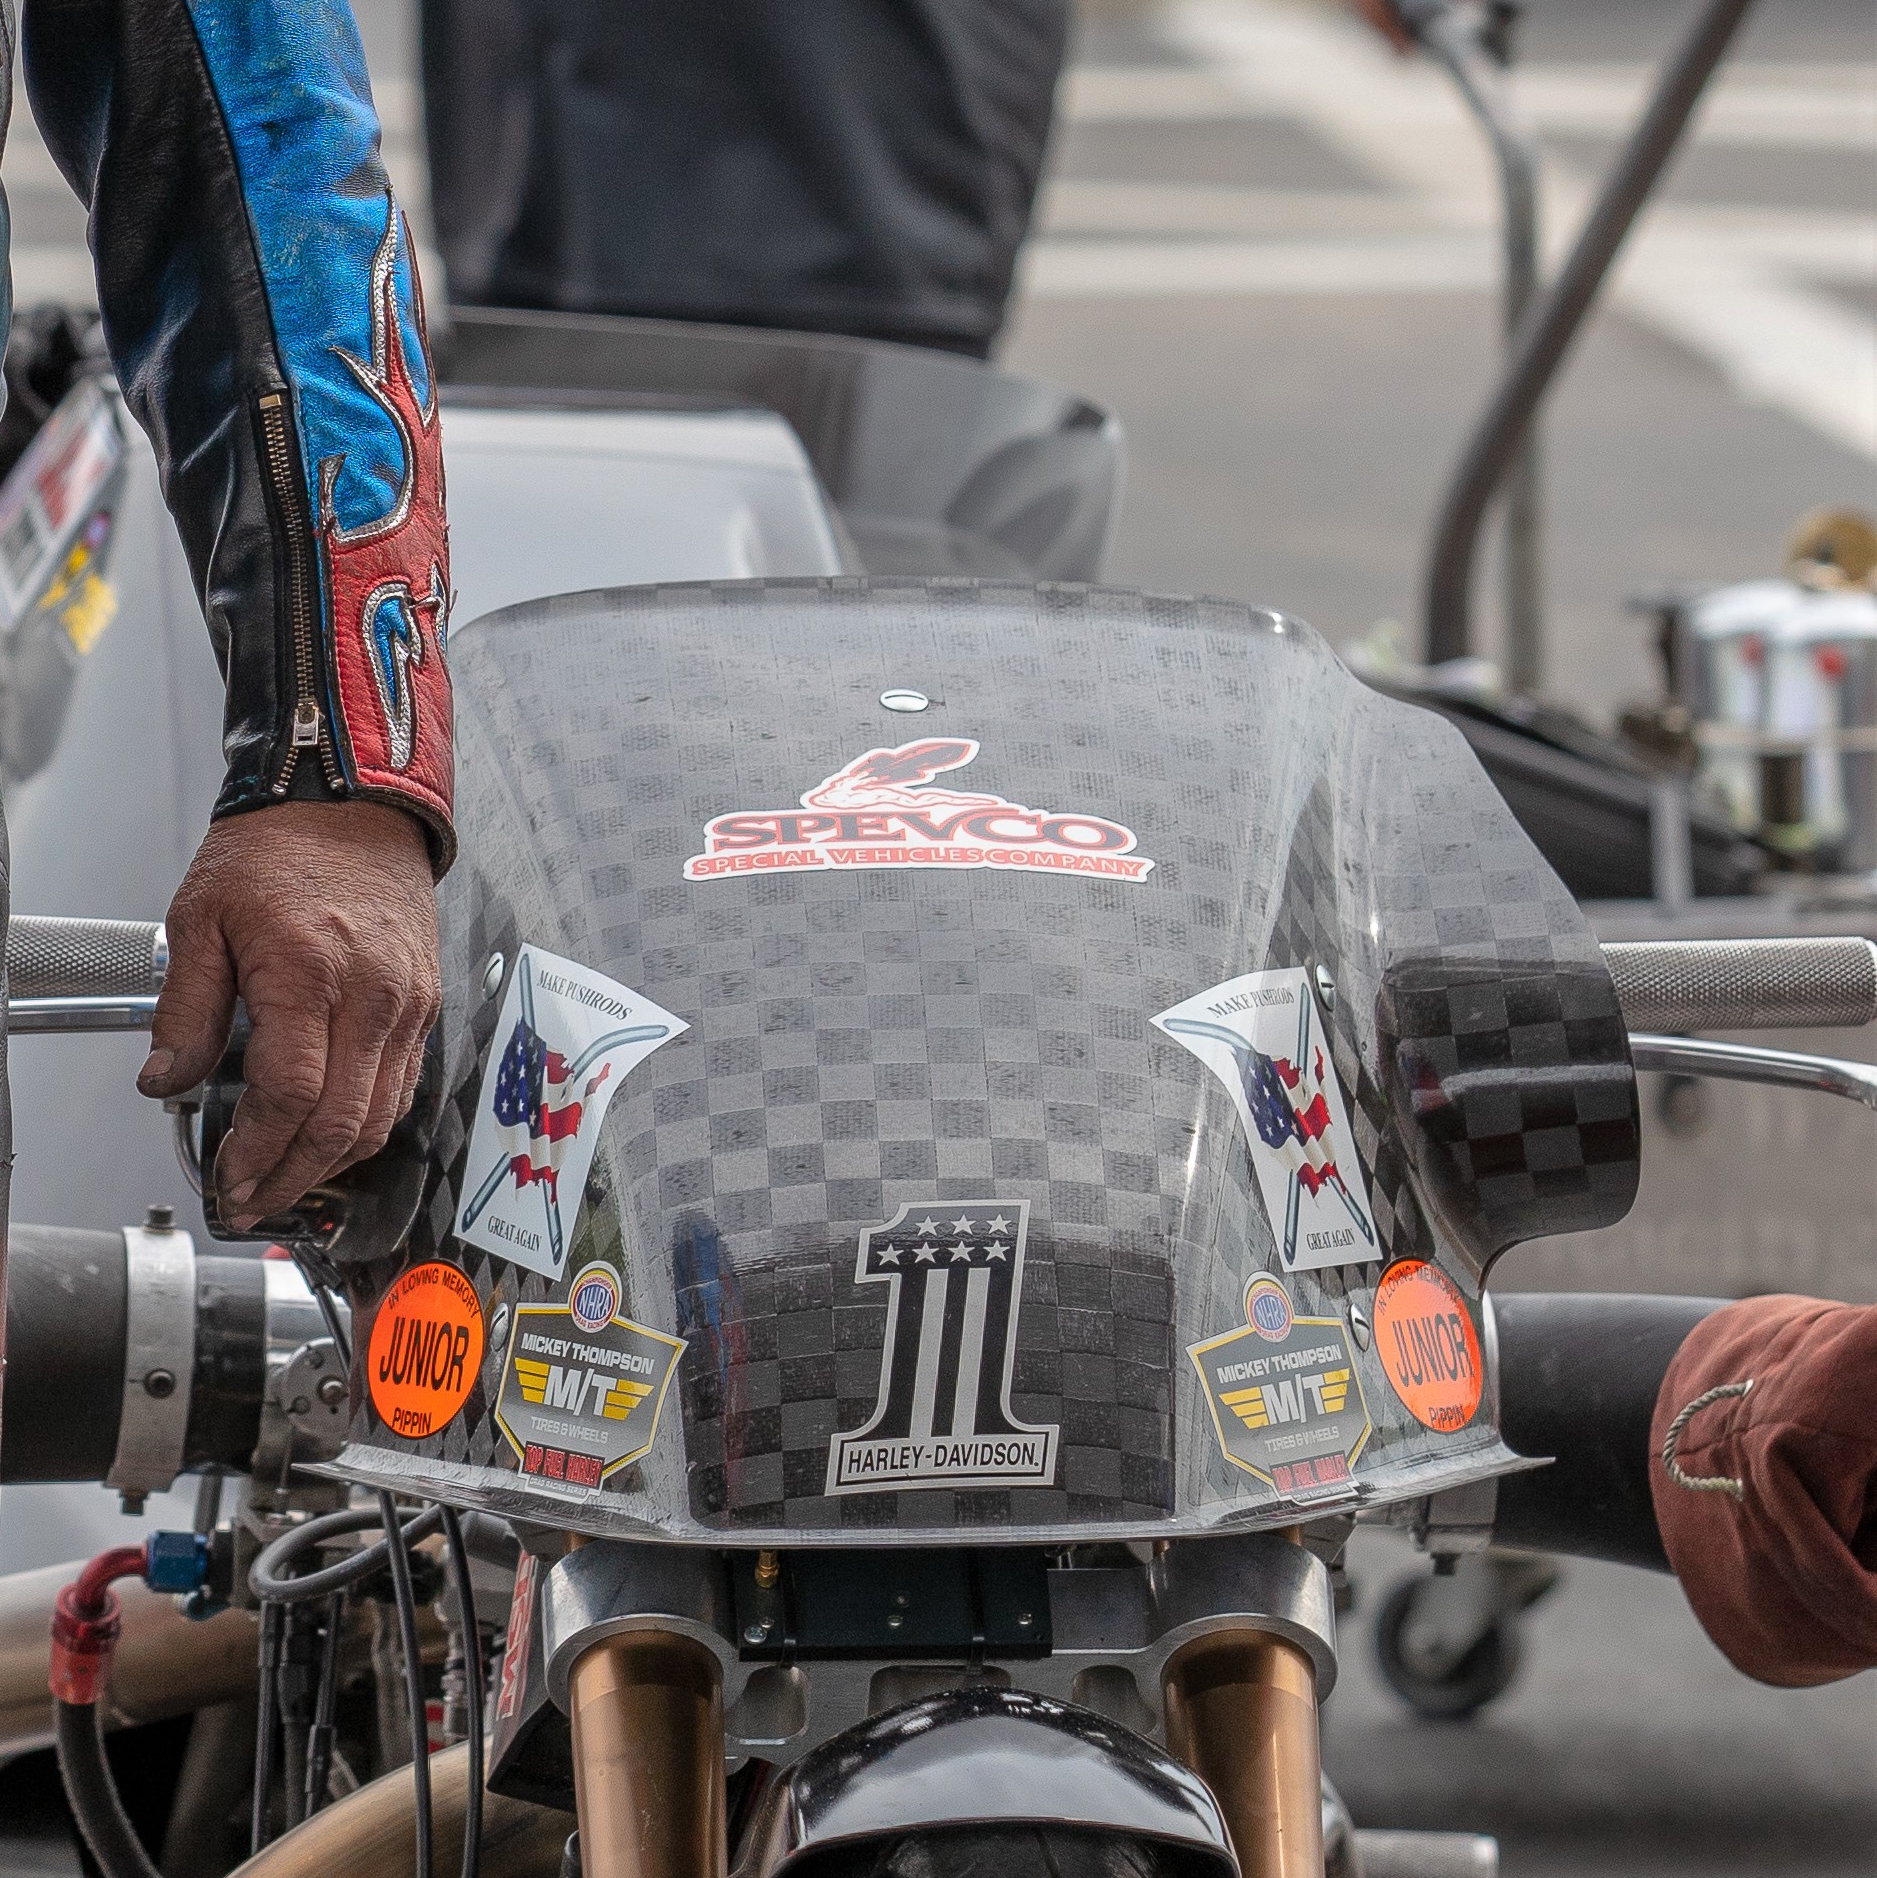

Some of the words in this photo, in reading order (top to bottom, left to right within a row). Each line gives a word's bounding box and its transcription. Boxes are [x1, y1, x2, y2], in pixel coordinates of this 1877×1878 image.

[713, 808, 1129, 854] SPEVCO
[695, 850, 823, 875] SPECIAL
[832, 847, 983, 866] VEHICLES
[985, 850, 1143, 876] COMPANY
[537, 970, 565, 995] MAKE
[565, 981, 633, 1020] PUSHRODS
[1206, 990, 1253, 1019] MAKE
[1252, 987, 1295, 1009] PUSHRODS
[488, 1215, 515, 1244] GREAT
[513, 1228, 543, 1252] AGAIN
[1306, 1231, 1332, 1251] GREAT
[1331, 1227, 1356, 1247] AGAIN
[388, 1291, 400, 1310] IN
[402, 1268, 439, 1296] LOVING
[442, 1273, 481, 1318] MEMORY
[1386, 1266, 1414, 1299] LOVING
[579, 1286, 610, 1319] NHRA
[380, 1316, 470, 1392] JUNIOR
[521, 1333, 573, 1358] MICKEY
[571, 1343, 655, 1375] THOMPSON
[1216, 1358, 1271, 1384] MICKEY
[1271, 1344, 1342, 1371] THOMPSON
[1392, 1313, 1475, 1388] JUNIOR
[544, 1365, 618, 1416] M/T
[1260, 1373, 1326, 1425] M/T
[392, 1408, 433, 1434] PIPPIN
[1428, 1403, 1466, 1428] PIPPIN
[524, 1444, 543, 1474] TOP
[543, 1448, 565, 1480] FUEL
